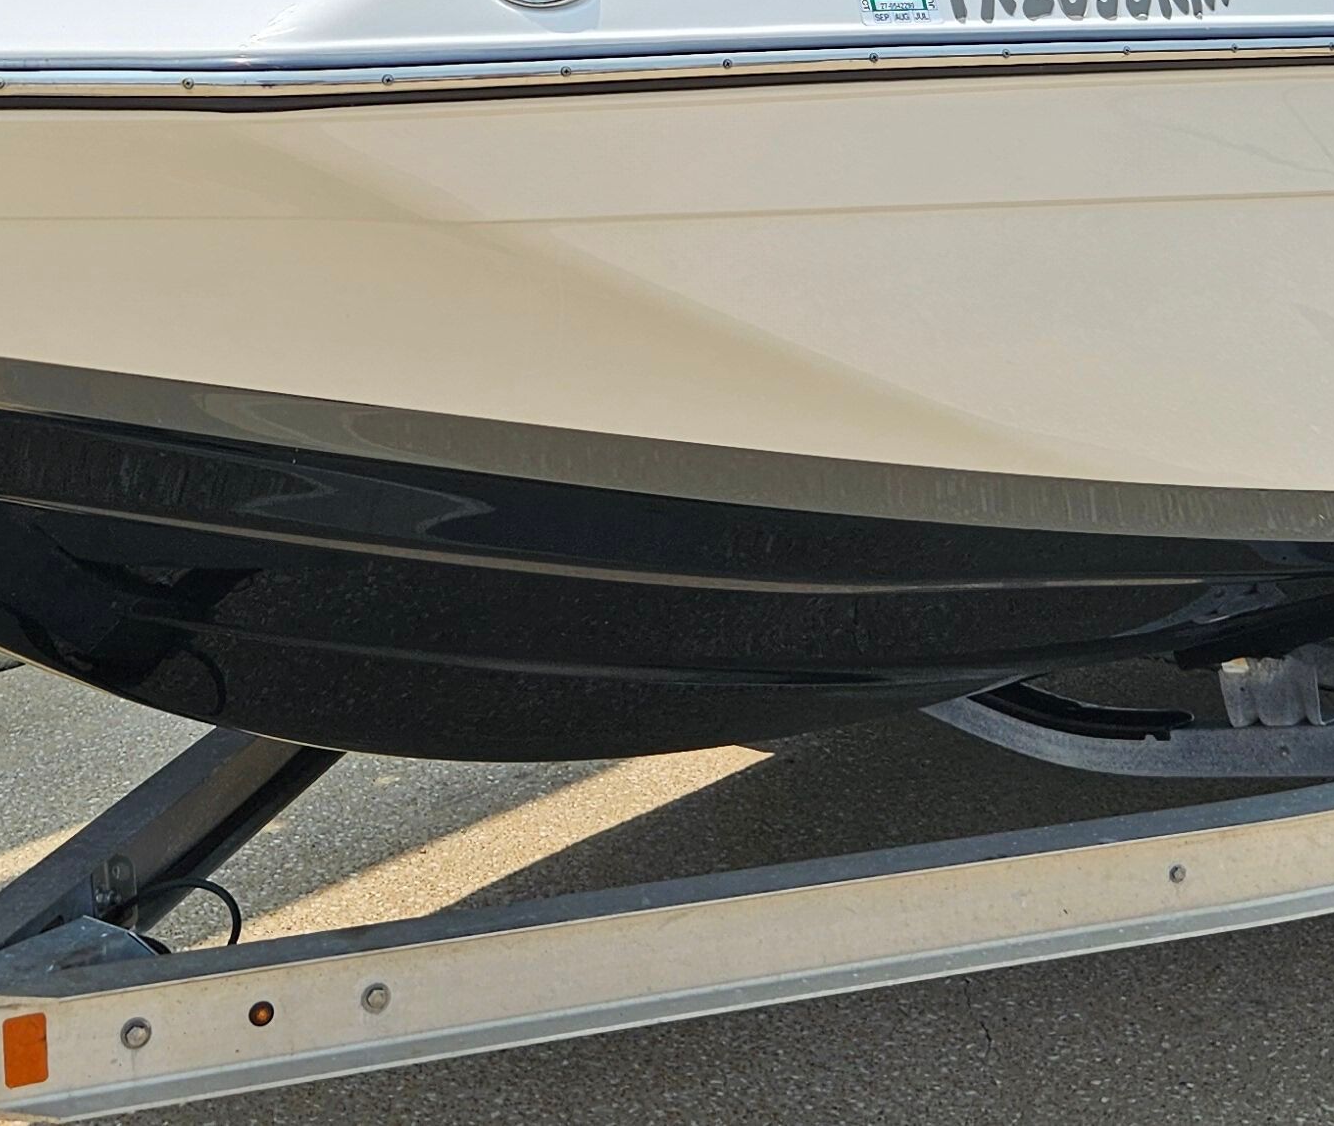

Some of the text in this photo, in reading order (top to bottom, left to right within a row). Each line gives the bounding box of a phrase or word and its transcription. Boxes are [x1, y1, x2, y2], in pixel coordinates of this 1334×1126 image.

[874, 12, 929, 22] SEP AUG JUL
